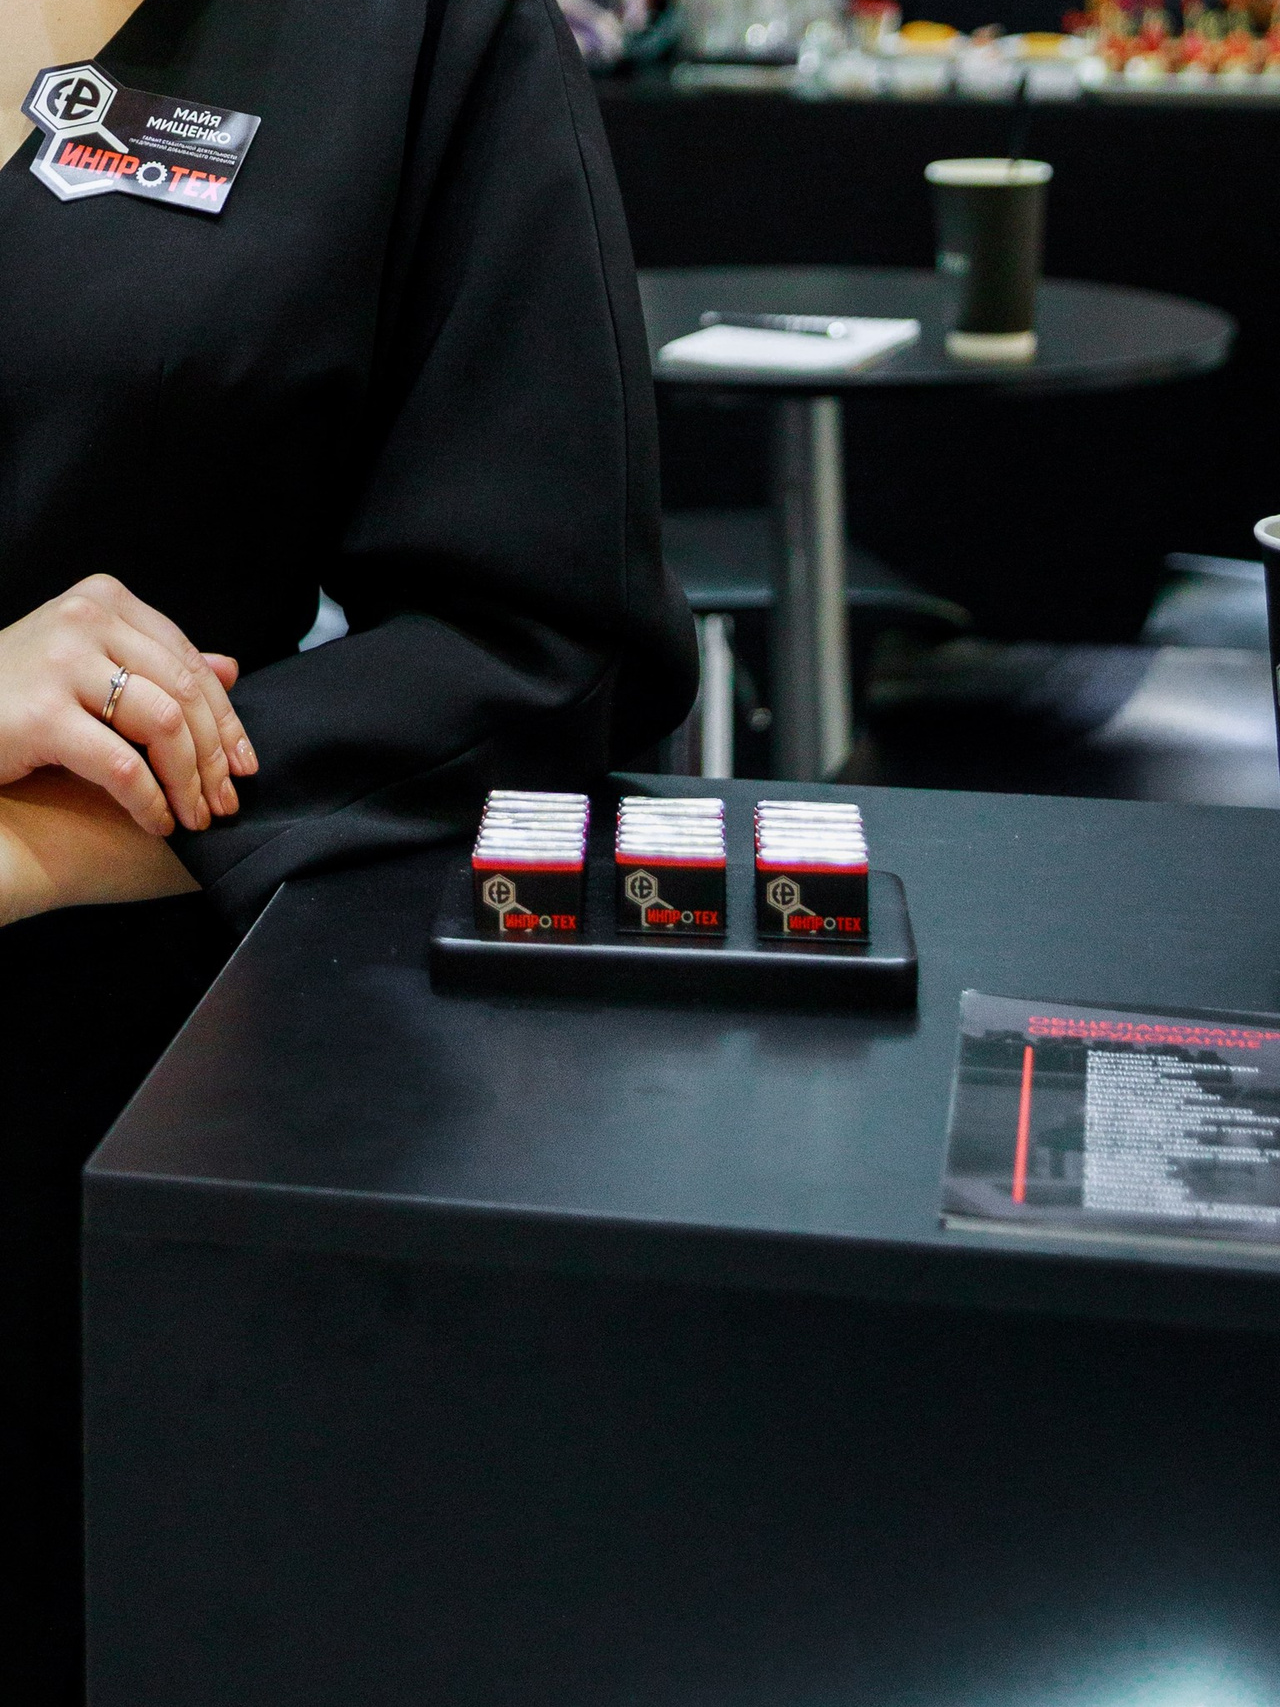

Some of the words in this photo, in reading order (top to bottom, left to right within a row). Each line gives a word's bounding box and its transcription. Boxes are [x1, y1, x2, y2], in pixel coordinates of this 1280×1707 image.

[173, 107, 222, 128] МАЙЯ
[146, 116, 232, 145] МИЩЕНКО
[129, 138, 167, 151] ПРЕДПРИЯТИЙ
[167, 146, 209, 160] ДОБЫВАЮЩЕГО
[209, 155, 236, 165] ПРОФИЛЯ
[142, 135, 162, 143] ГАРАНТ
[163, 139, 196, 151] СТАБИЛЬНОЙ
[197, 147, 238, 160] ДЕЯТЕЛЬНОСТИ
[1087, 1050, 1178, 1062] Манометры
[1157, 1061, 1259, 1072] температуры
